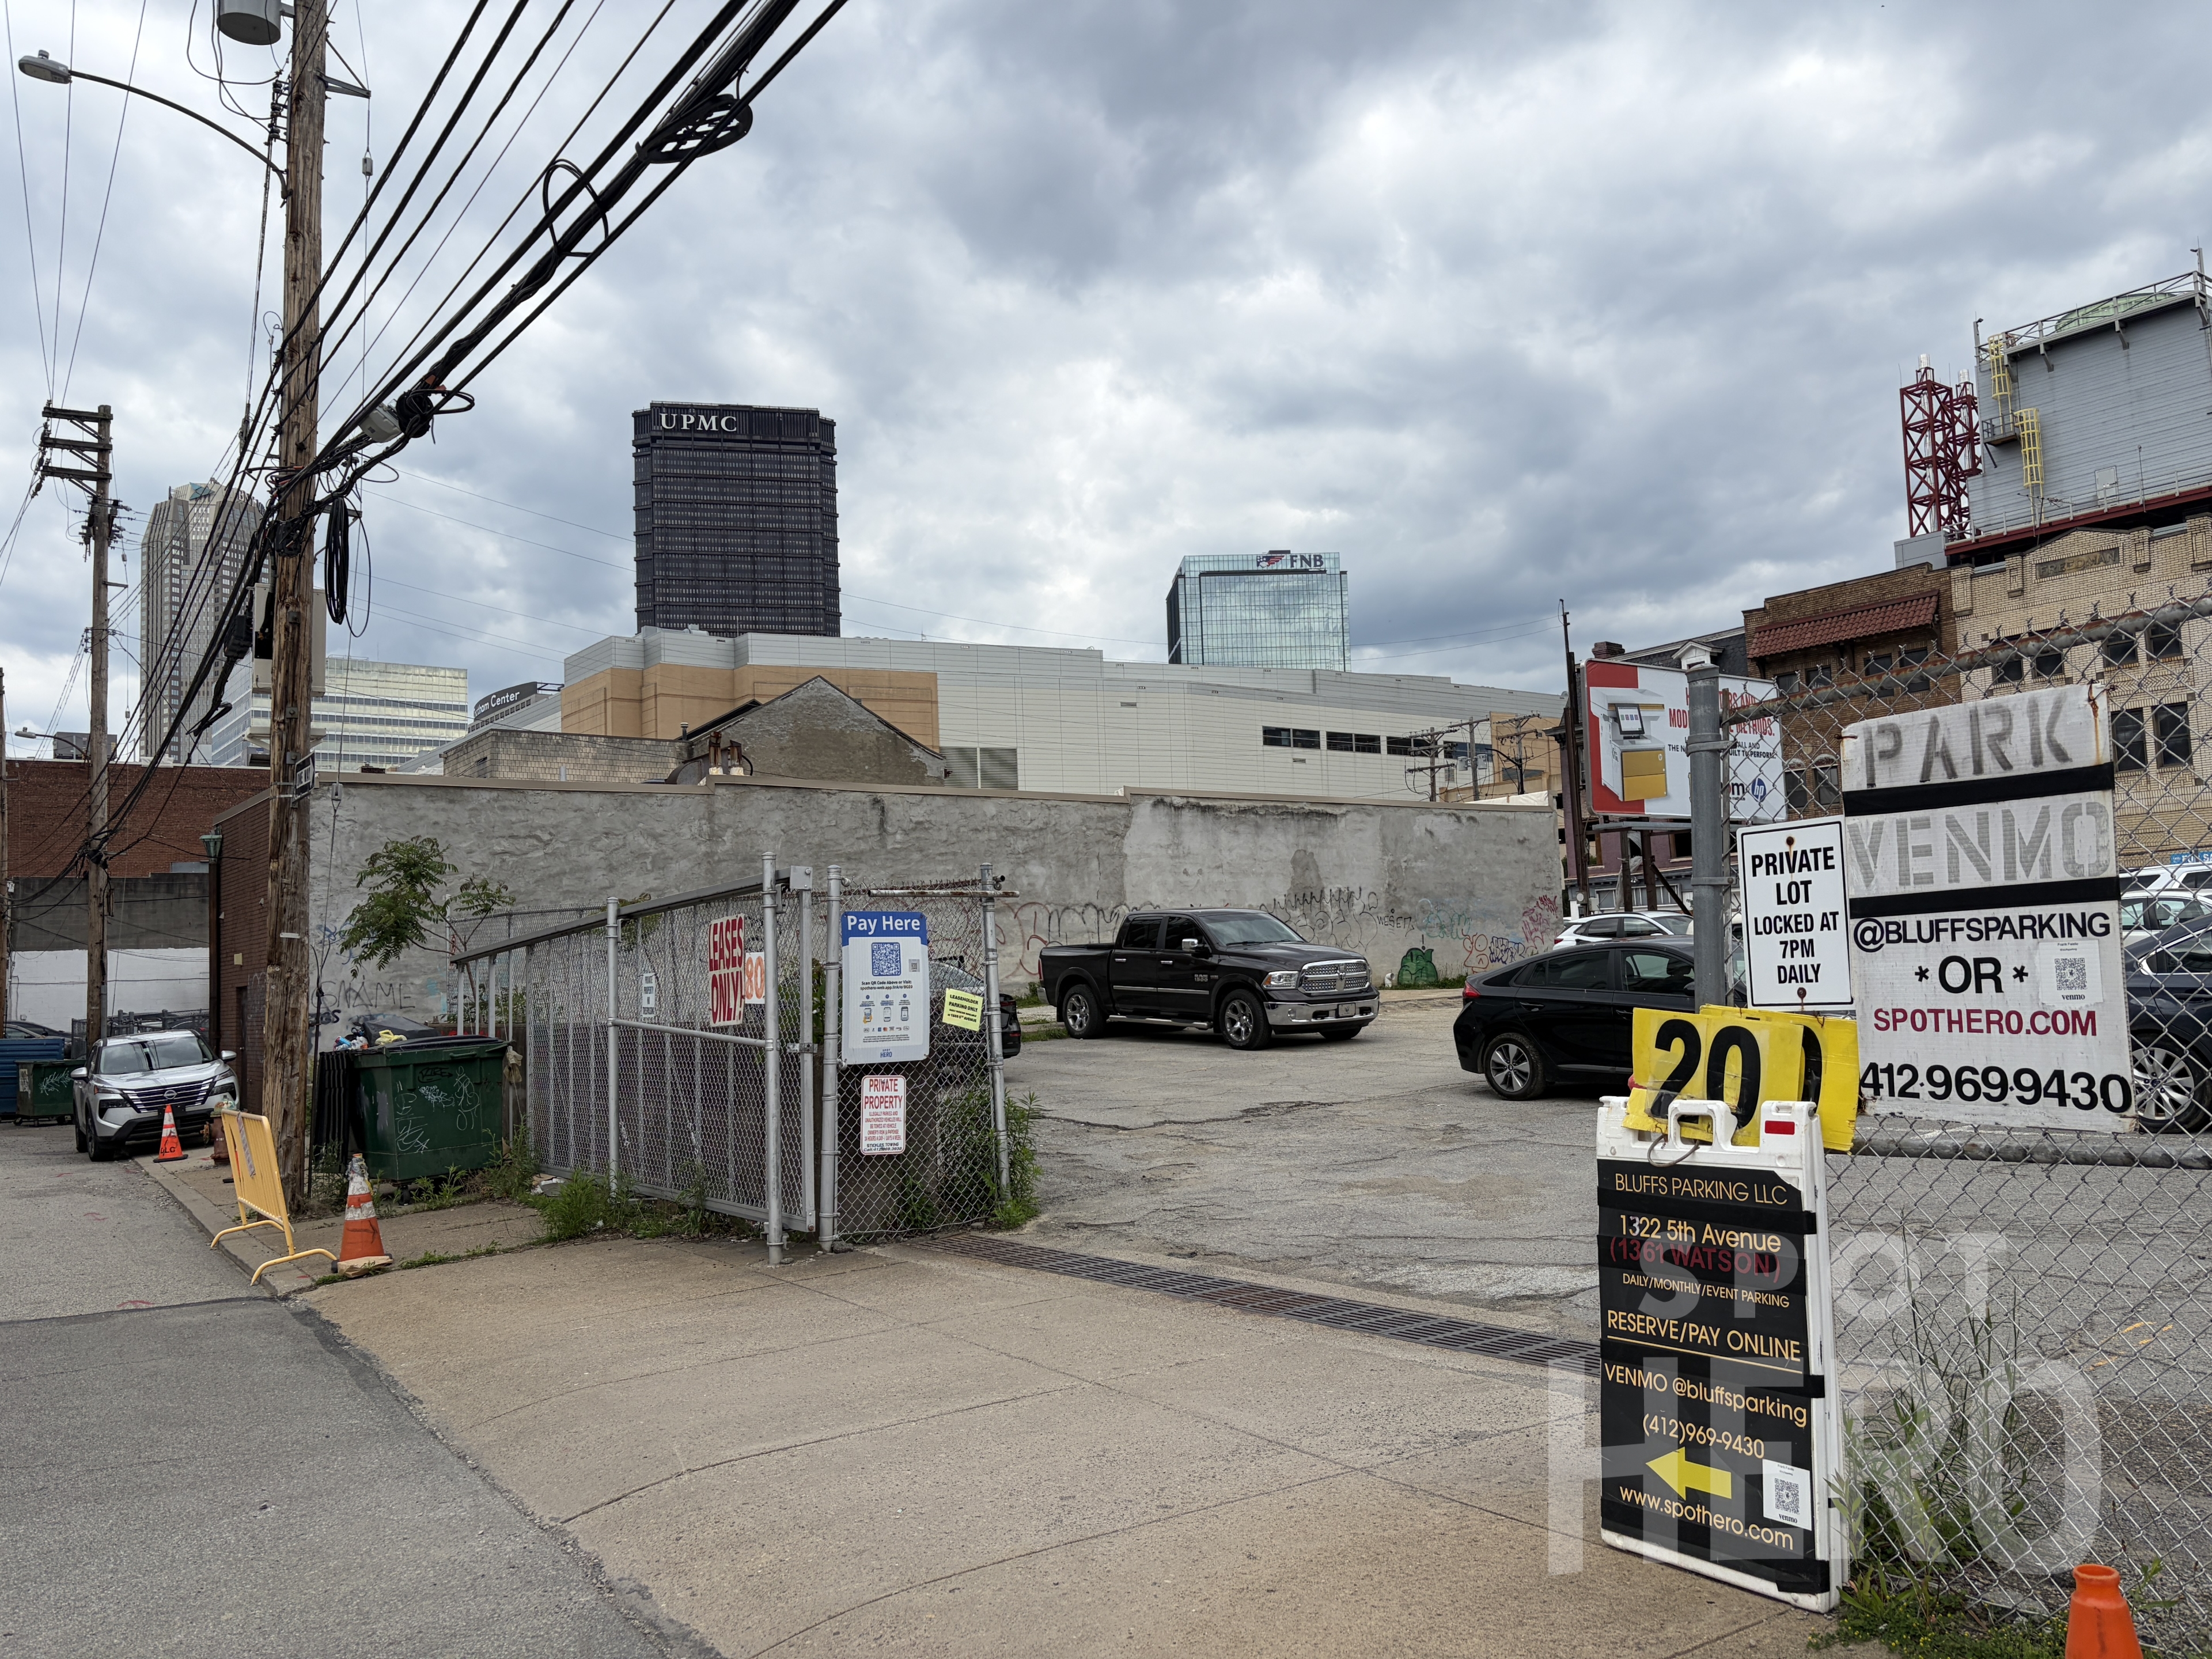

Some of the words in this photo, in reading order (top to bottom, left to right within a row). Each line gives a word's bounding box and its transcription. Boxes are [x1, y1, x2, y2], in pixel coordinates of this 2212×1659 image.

[659, 413, 737, 431] UPMC
[1290, 554, 1324, 568] FNB
[2040, 550, 2116, 574] FREEDMAN
[491, 692, 520, 707] Center
[1668, 744, 1679, 752] THE
[1862, 695, 2073, 788] PARK
[1753, 778, 1765, 802] hp
[1847, 802, 2109, 890] VENMO
[1751, 846, 1835, 877] PRIVATE
[1776, 880, 1812, 905] LOT
[847, 915, 877, 935] Pay
[882, 915, 920, 931] Here
[1754, 913, 1814, 935] LOCKED
[1820, 911, 1839, 931] AT
[1854, 912, 2111, 953] @BLUFFSPARKING
[709, 916, 743, 972] LEASES
[1779, 938, 1815, 959] 7PM
[745, 956, 764, 999] 80
[1777, 963, 1821, 984] DAILY
[711, 969, 743, 1024] ONLY!
[950, 994, 978, 1005] LEASEHOLDER
[1874, 1008, 2097, 1036] SPOTHERO.COM
[869, 1078, 898, 1092] PRIVATE
[864, 1095, 903, 1109] PROPERTY
[1615, 1173, 1668, 1195] BLUFFS
[1672, 1177, 1749, 1202] PARKING
[1755, 1183, 1787, 1205] LLC
[1620, 1214, 1661, 1238] 1322
[1667, 1219, 1696, 1243] 5th
[1702, 1224, 1781, 1252] Avenue
[1610, 1237, 1665, 1264] (1361
[1670, 1243, 1781, 1283] WATSON)
[1623, 1273, 1738, 1300] DAILY/MONTHLY/EVENT
[1741, 1290, 1790, 1308] PARKING
[1608, 1310, 1720, 1347] RESERVE/PAY
[1727, 1330, 1801, 1362] ONLINE
[1605, 1363, 1668, 1392] VENMO
[1672, 1377, 1807, 1427] @bluffsparking
[1643, 1413, 1765, 1459] (412)969-9430
[1619, 1486, 1793, 1551] www.spothero.com
[1779, 1514, 1798, 1524] venmo
